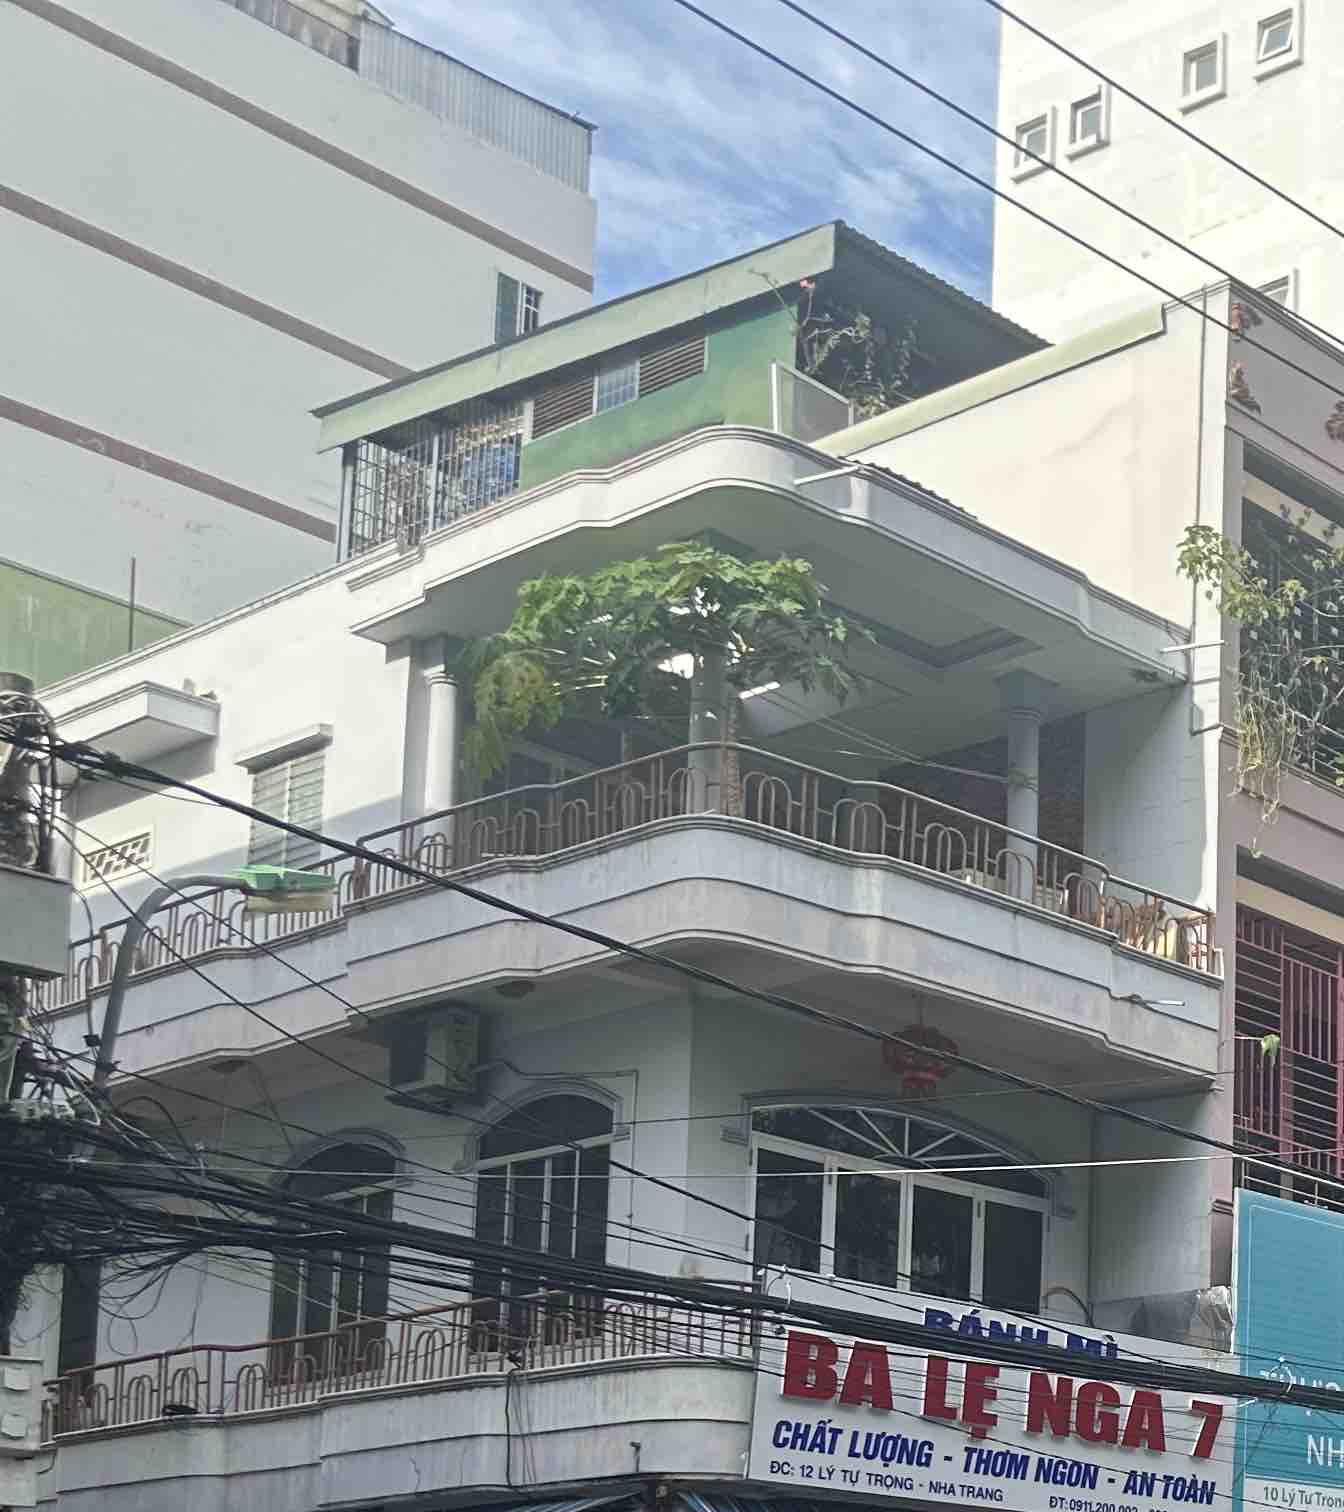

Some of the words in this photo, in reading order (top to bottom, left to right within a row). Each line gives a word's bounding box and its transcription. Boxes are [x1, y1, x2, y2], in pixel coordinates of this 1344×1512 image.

[782, 1330, 894, 1410] BA
[920, 1354, 1000, 1440] LẸ
[1187, 1398, 1224, 1459] 7
[772, 1419, 843, 1456] CHẤT
[848, 1431, 934, 1470] LƯỢNG
[963, 1447, 1028, 1483] THƠM
[1034, 1457, 1100, 1490] NGON
[1122, 1470, 1156, 1498] AN
[1161, 1472, 1217, 1506] TOÀN
[799, 1464, 814, 1479] 12
[817, 1465, 836, 1481] LÝ
[928, 1480, 957, 1497] NHA
[958, 1484, 1004, 1503] TRANG
[1263, 1486, 1279, 1502] 10
